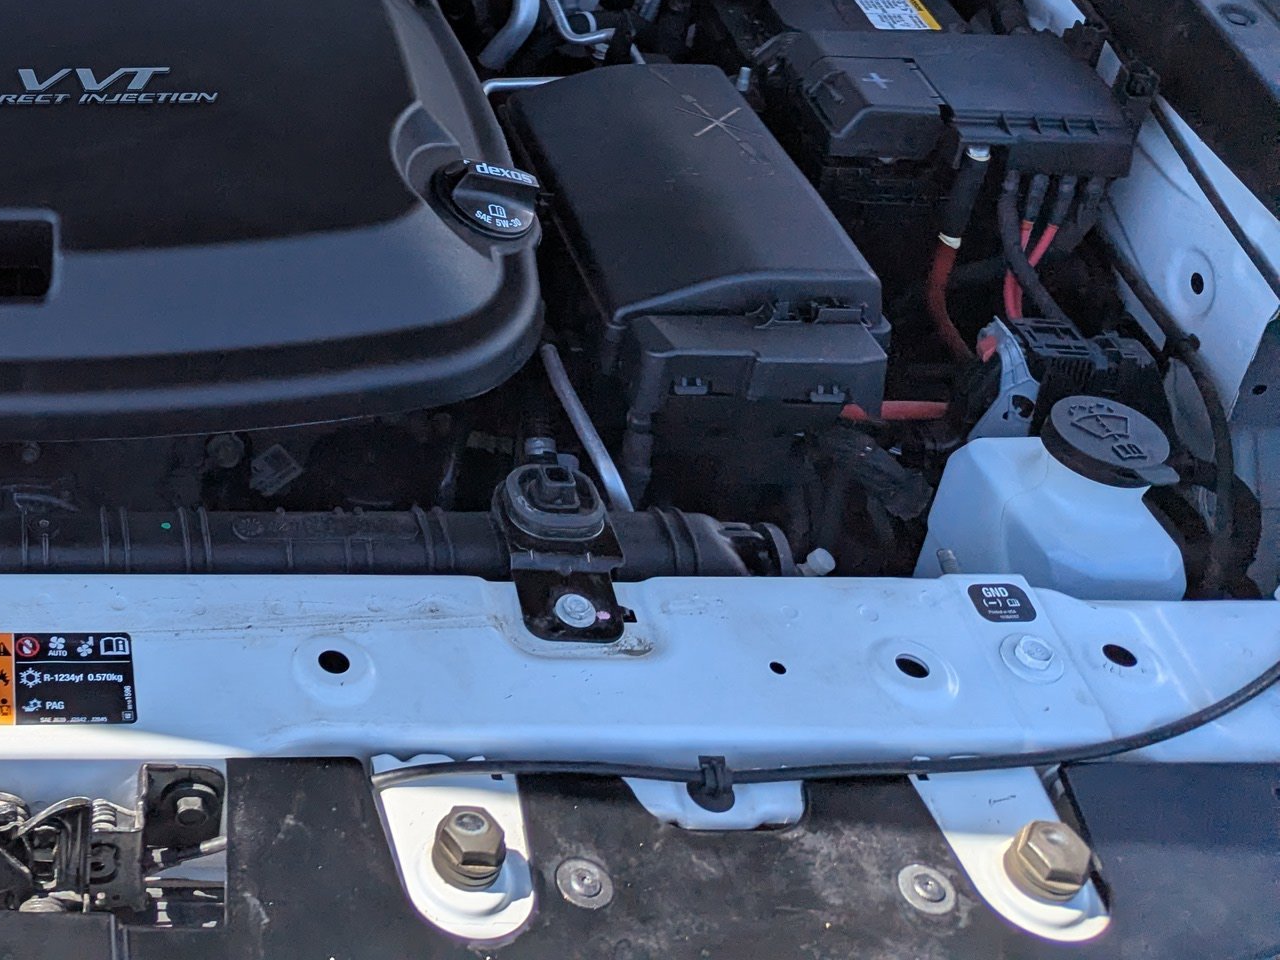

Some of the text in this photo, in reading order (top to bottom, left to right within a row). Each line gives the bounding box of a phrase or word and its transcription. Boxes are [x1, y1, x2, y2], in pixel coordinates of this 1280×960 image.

[18, 67, 171, 92] VVT
[78, 91, 218, 104] INJECTION
[475, 162, 534, 184] dexos
[475, 210, 522, 228] SAE 5W-30
[981, 587, 1009, 598] GND
[43, 673, 123, 683] R-1234yf 0.570kg
[45, 701, 65, 710] PAG
